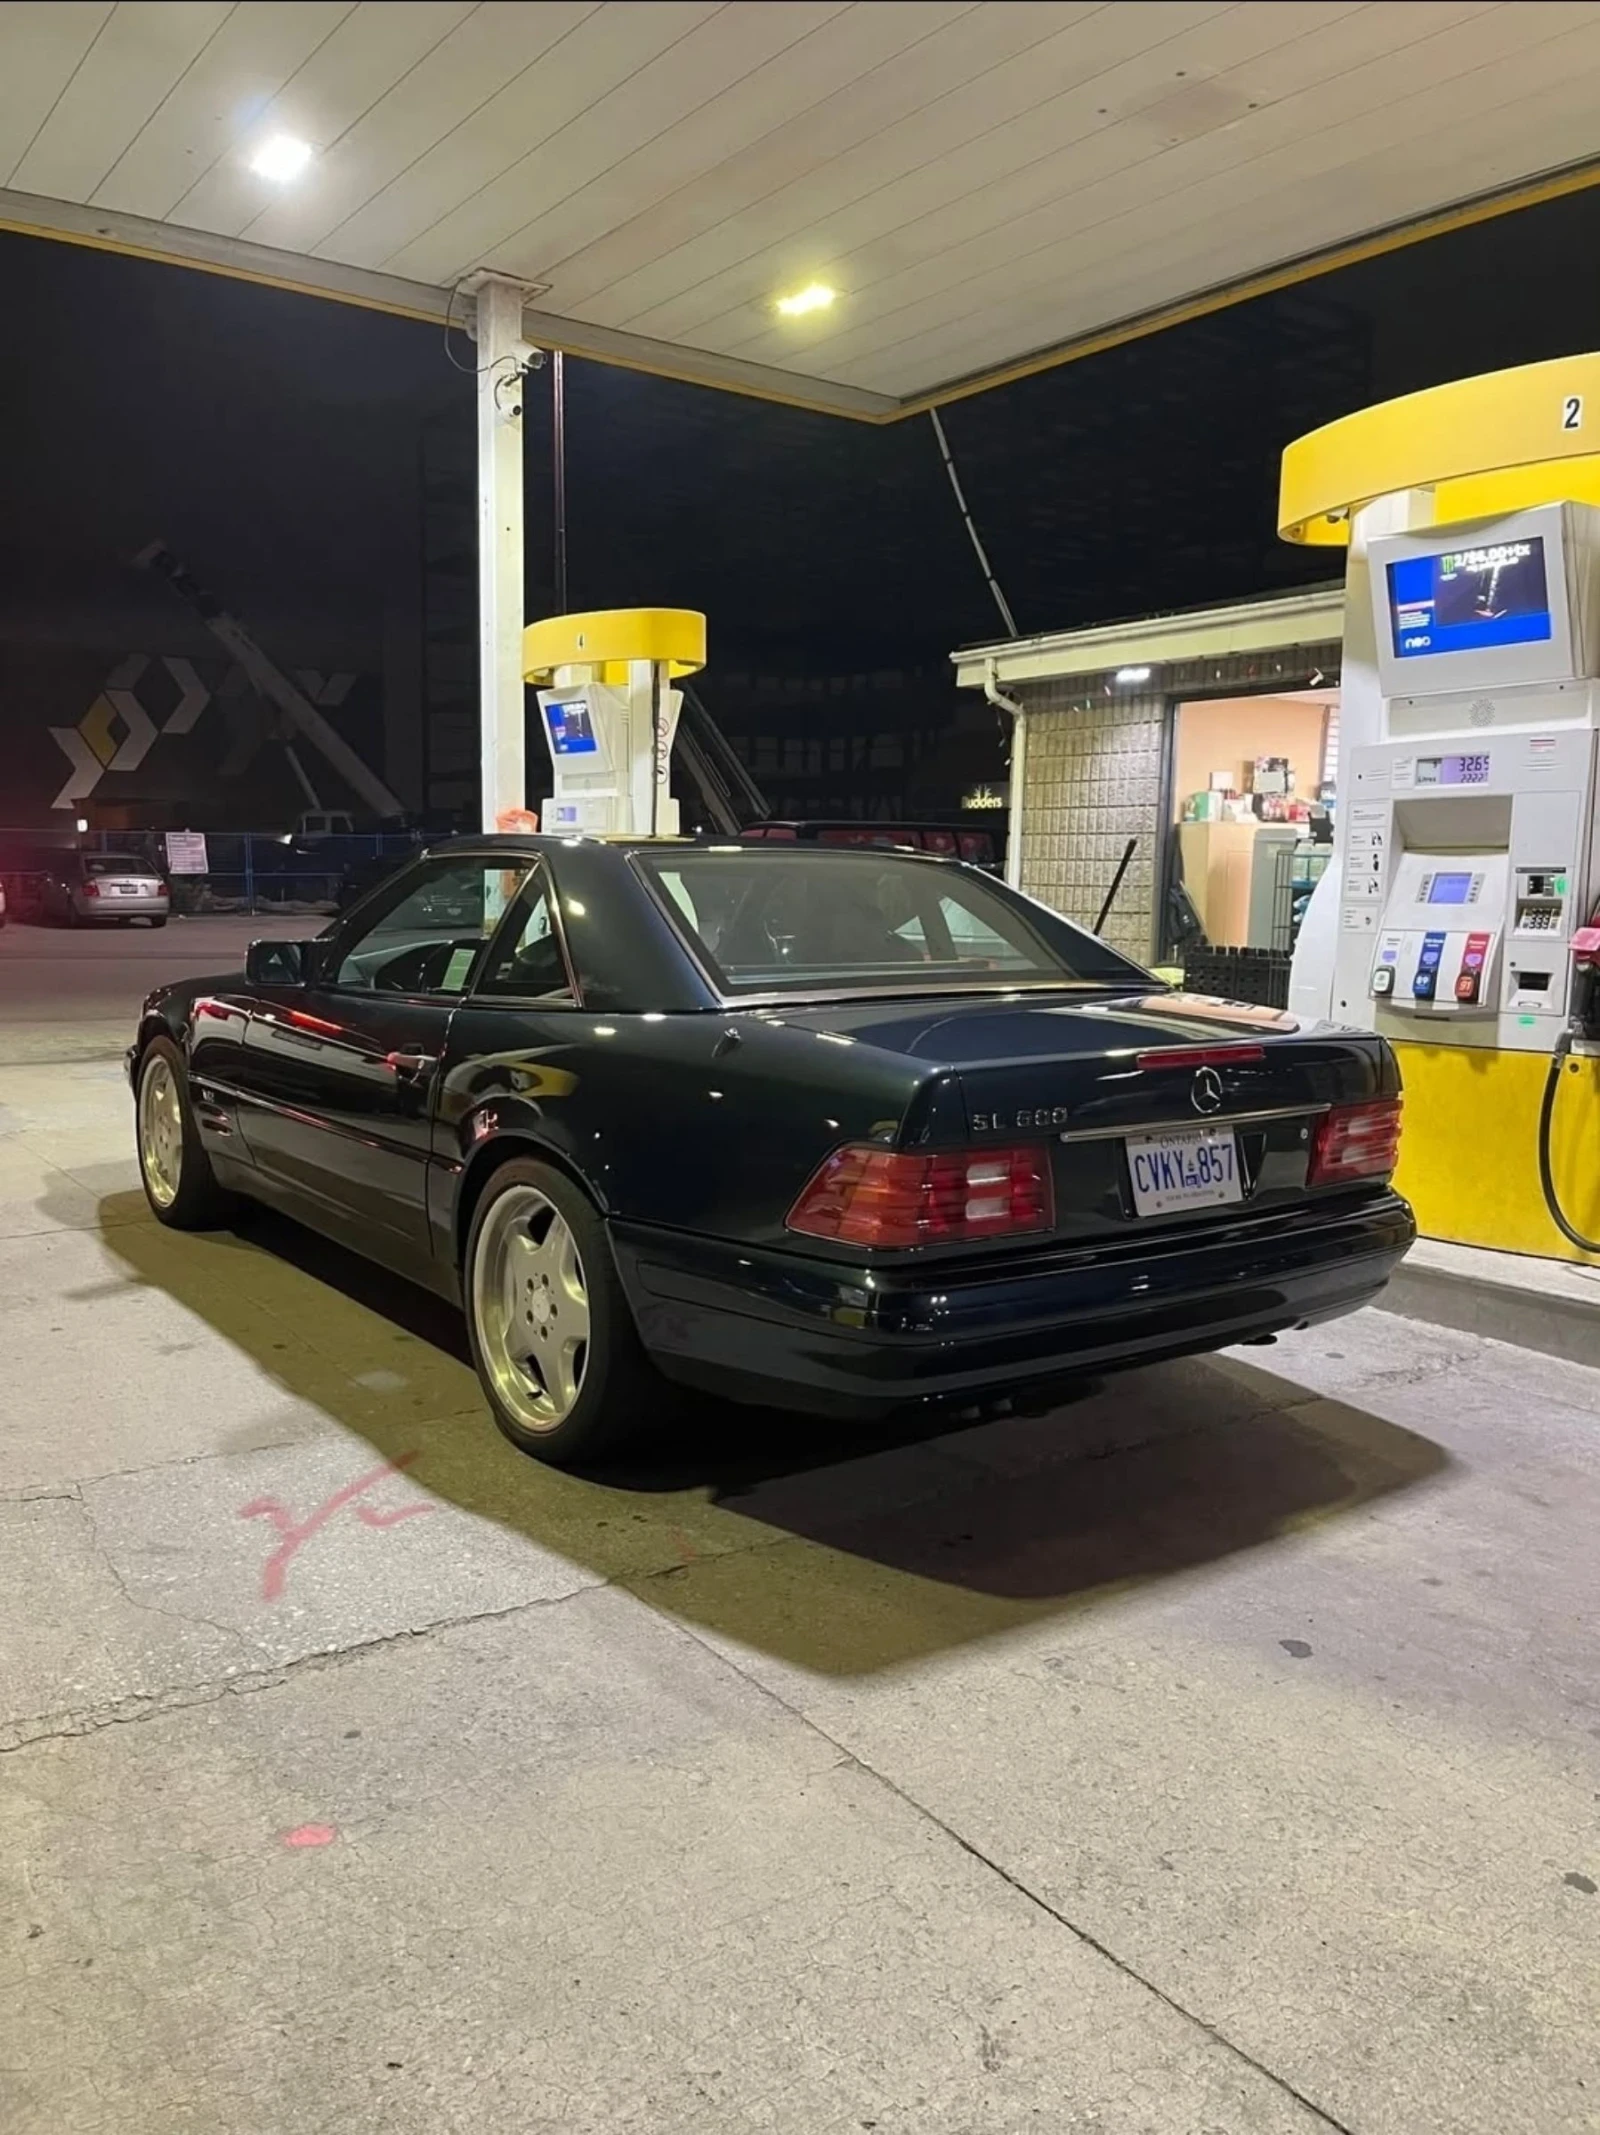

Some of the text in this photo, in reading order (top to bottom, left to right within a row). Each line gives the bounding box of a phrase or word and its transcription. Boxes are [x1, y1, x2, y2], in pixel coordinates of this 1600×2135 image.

[1564, 398, 1580, 429] 2
[973, 1106, 1068, 1131] SL 600
[1134, 1143, 1232, 1193] CVKY 857
